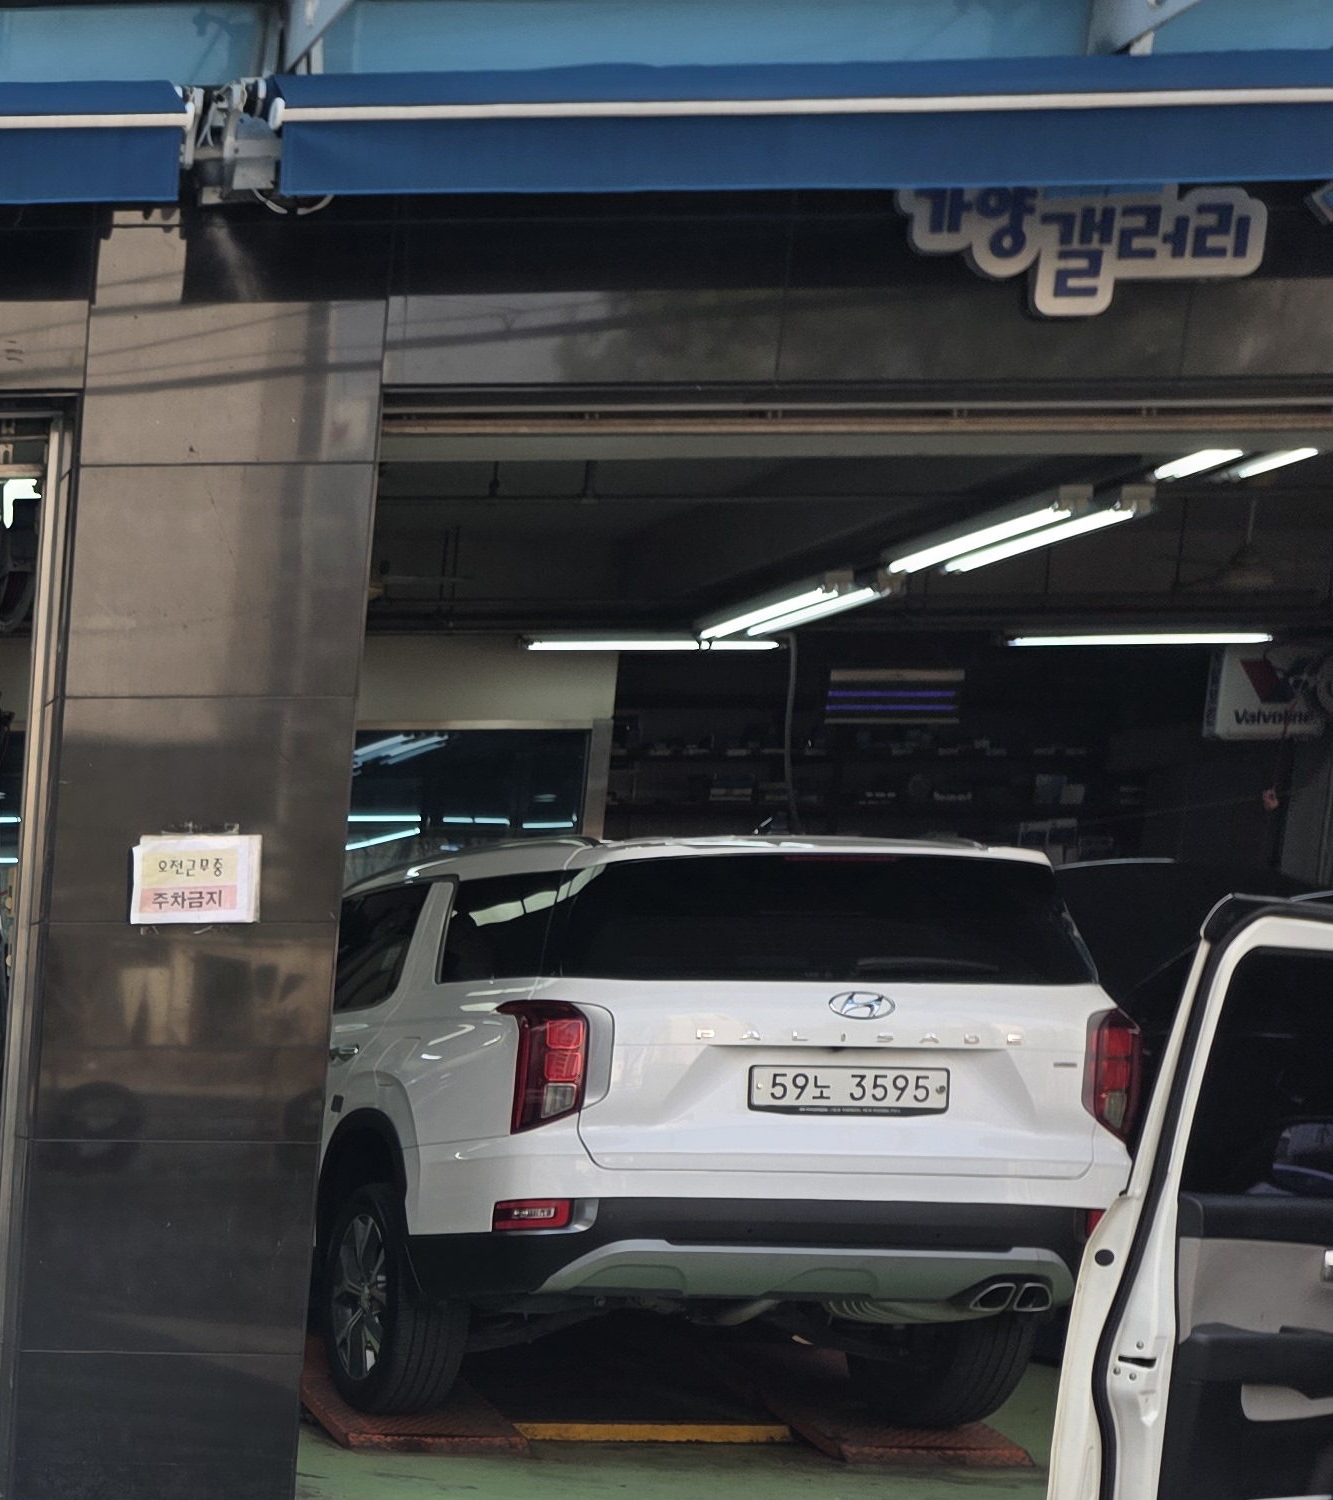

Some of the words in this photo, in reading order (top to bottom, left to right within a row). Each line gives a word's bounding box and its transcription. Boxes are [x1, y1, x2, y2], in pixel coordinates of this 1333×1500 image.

[1040, 203, 1251, 297] 갤러리
[152, 889, 223, 909] 주차금지
[696, 1029, 1023, 1045] PALISADE
[770, 1072, 832, 1101] 59노
[849, 1074, 931, 1103] 3595
